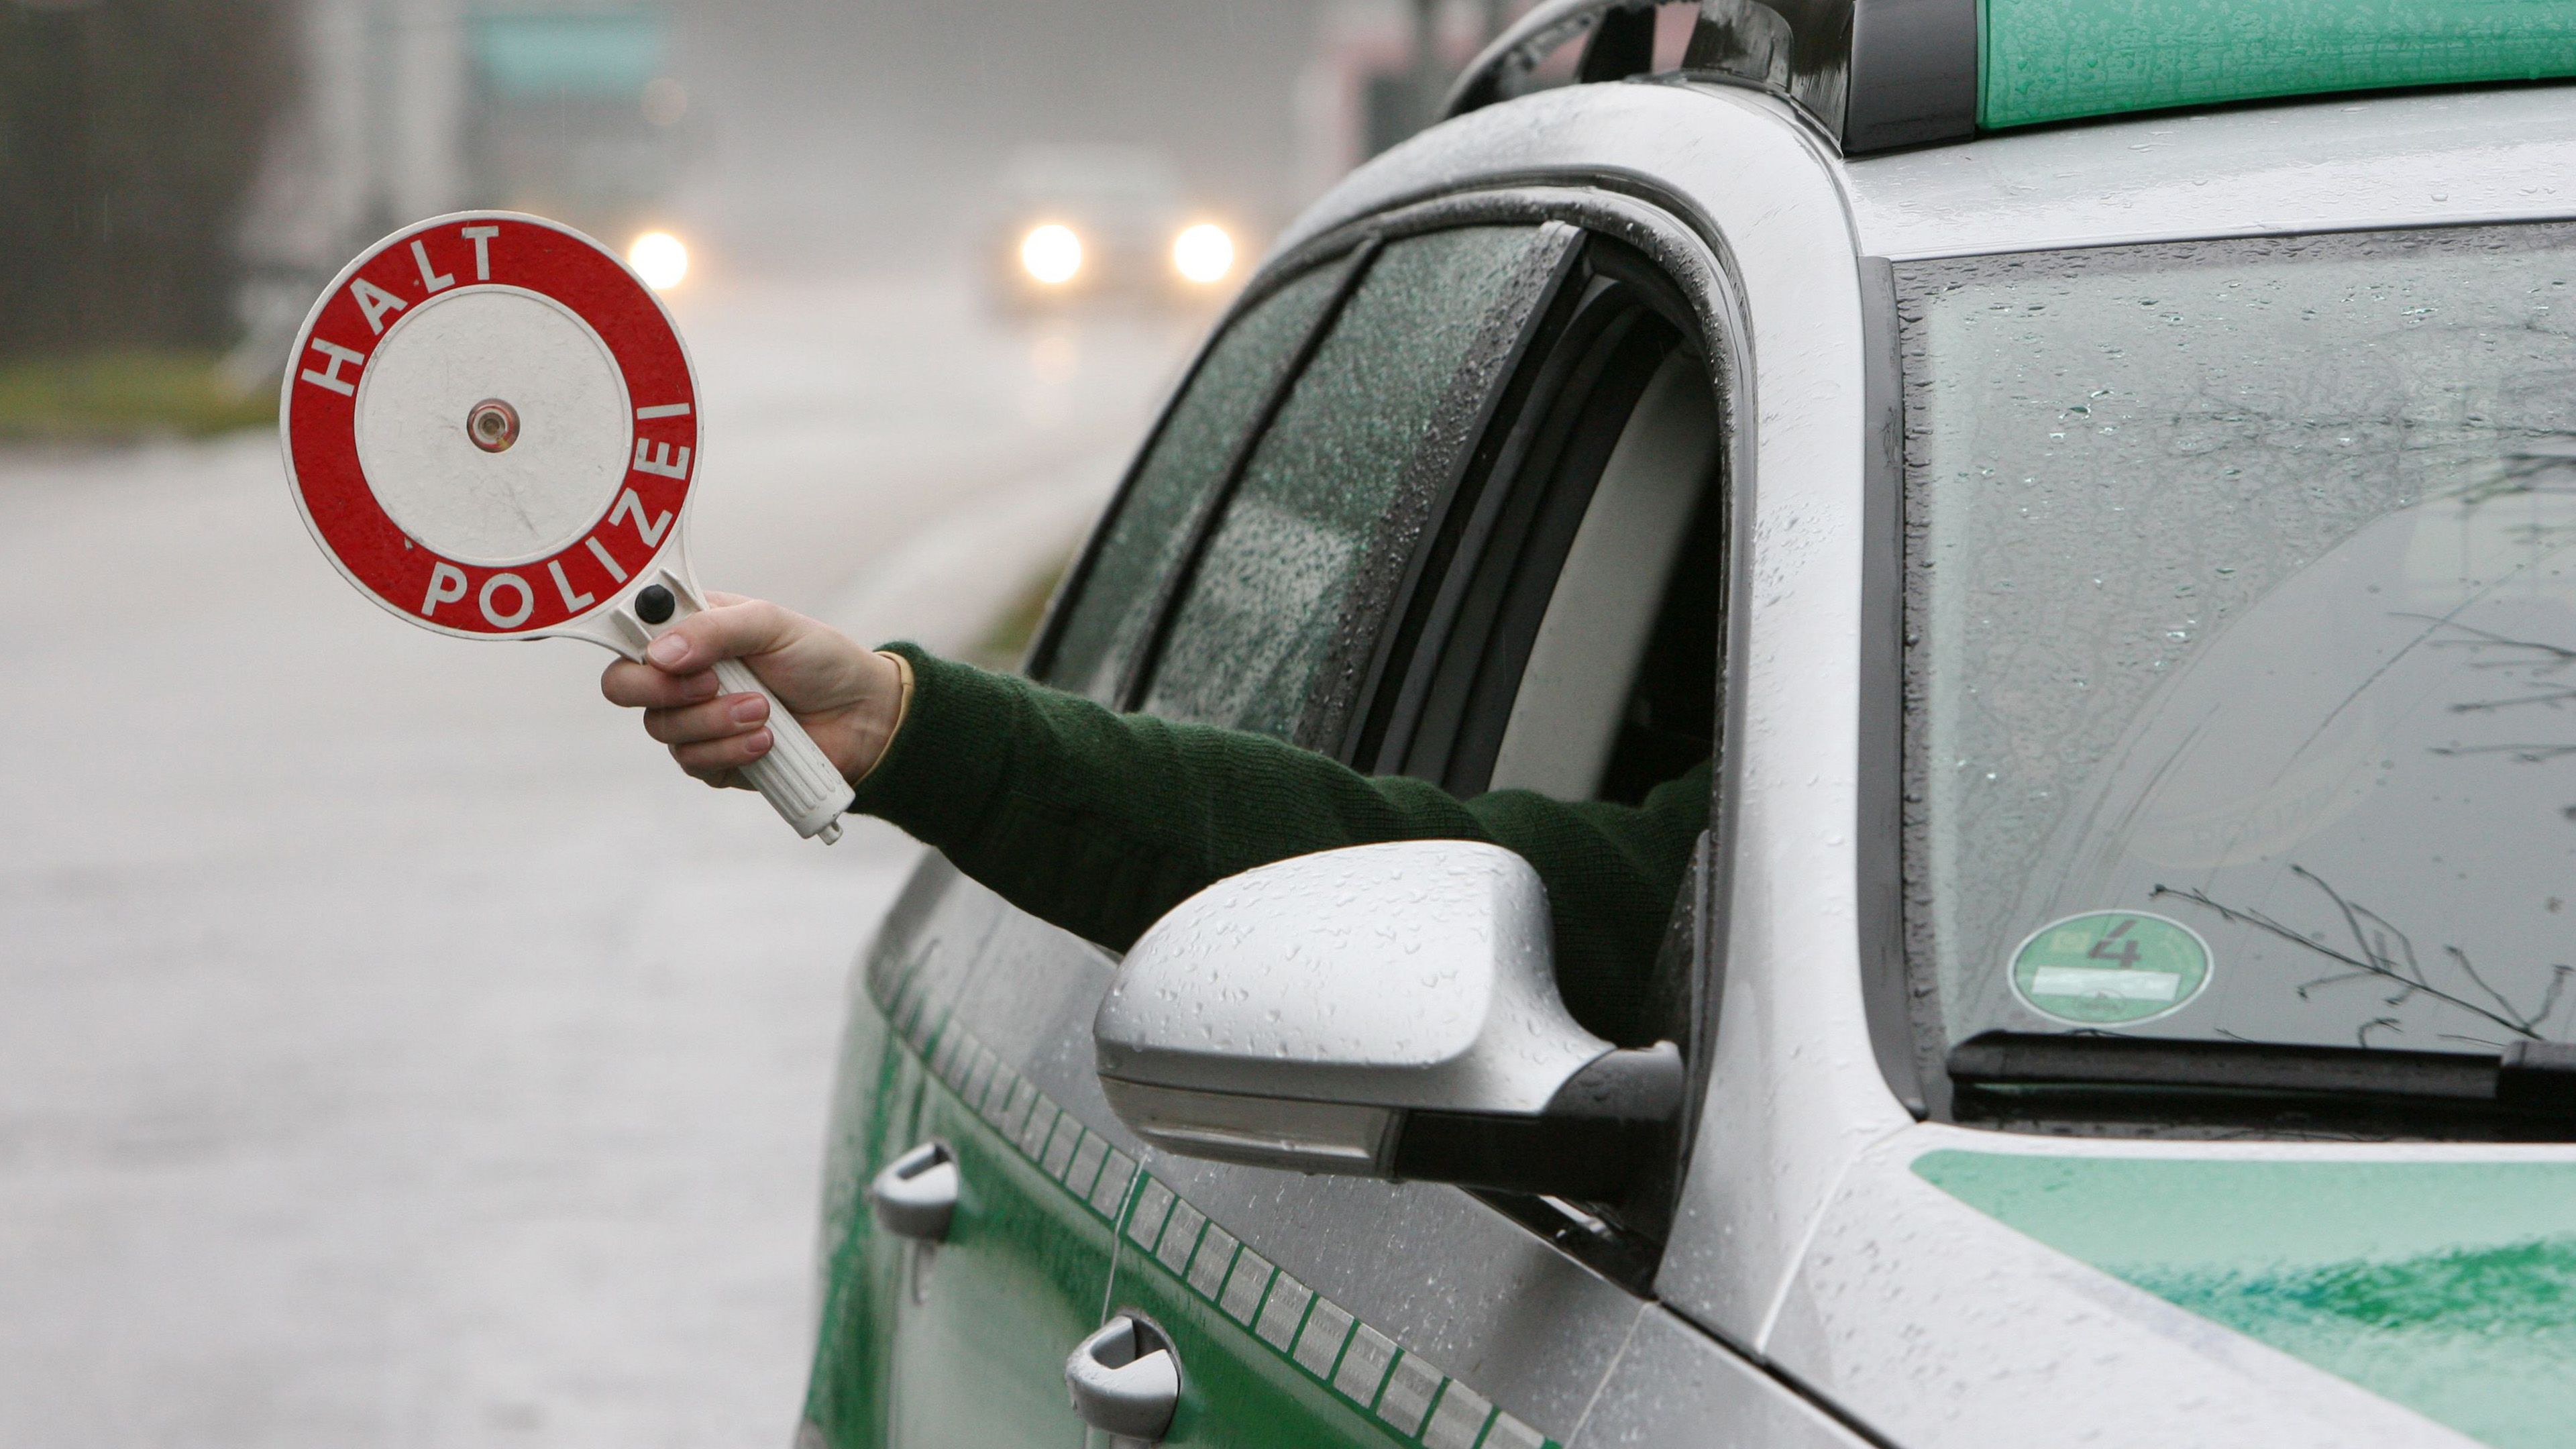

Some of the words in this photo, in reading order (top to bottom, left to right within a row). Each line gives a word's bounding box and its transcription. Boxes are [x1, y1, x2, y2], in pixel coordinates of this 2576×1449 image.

[301, 225, 499, 397] HALT
[421, 402, 690, 628] POLIZEI
[2088, 920, 2141, 967] 4
